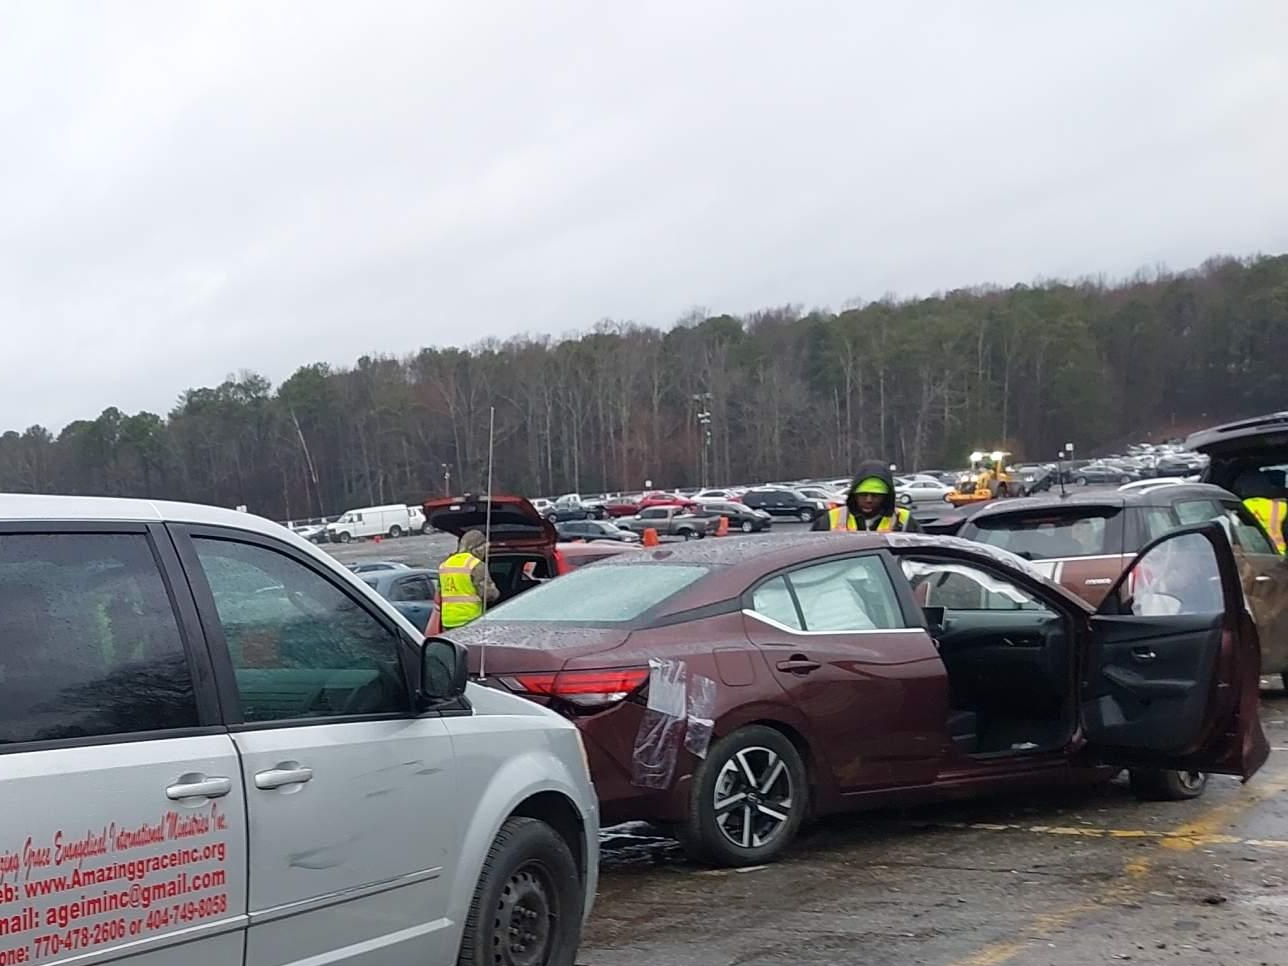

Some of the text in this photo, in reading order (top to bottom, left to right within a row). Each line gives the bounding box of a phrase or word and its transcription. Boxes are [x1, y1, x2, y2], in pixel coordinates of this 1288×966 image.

[23, 836, 51, 881] Grace
[54, 827, 107, 870] Evangelical
[109, 816, 165, 853] International
[24, 843, 226, 899] www.Amazinggraceinc.org
[34, 918, 125, 958] 770-478-2606
[129, 919, 143, 936] or
[146, 893, 227, 929] 404-749-8058
[46, 869, 226, 928] ageiminc@gmail.com
